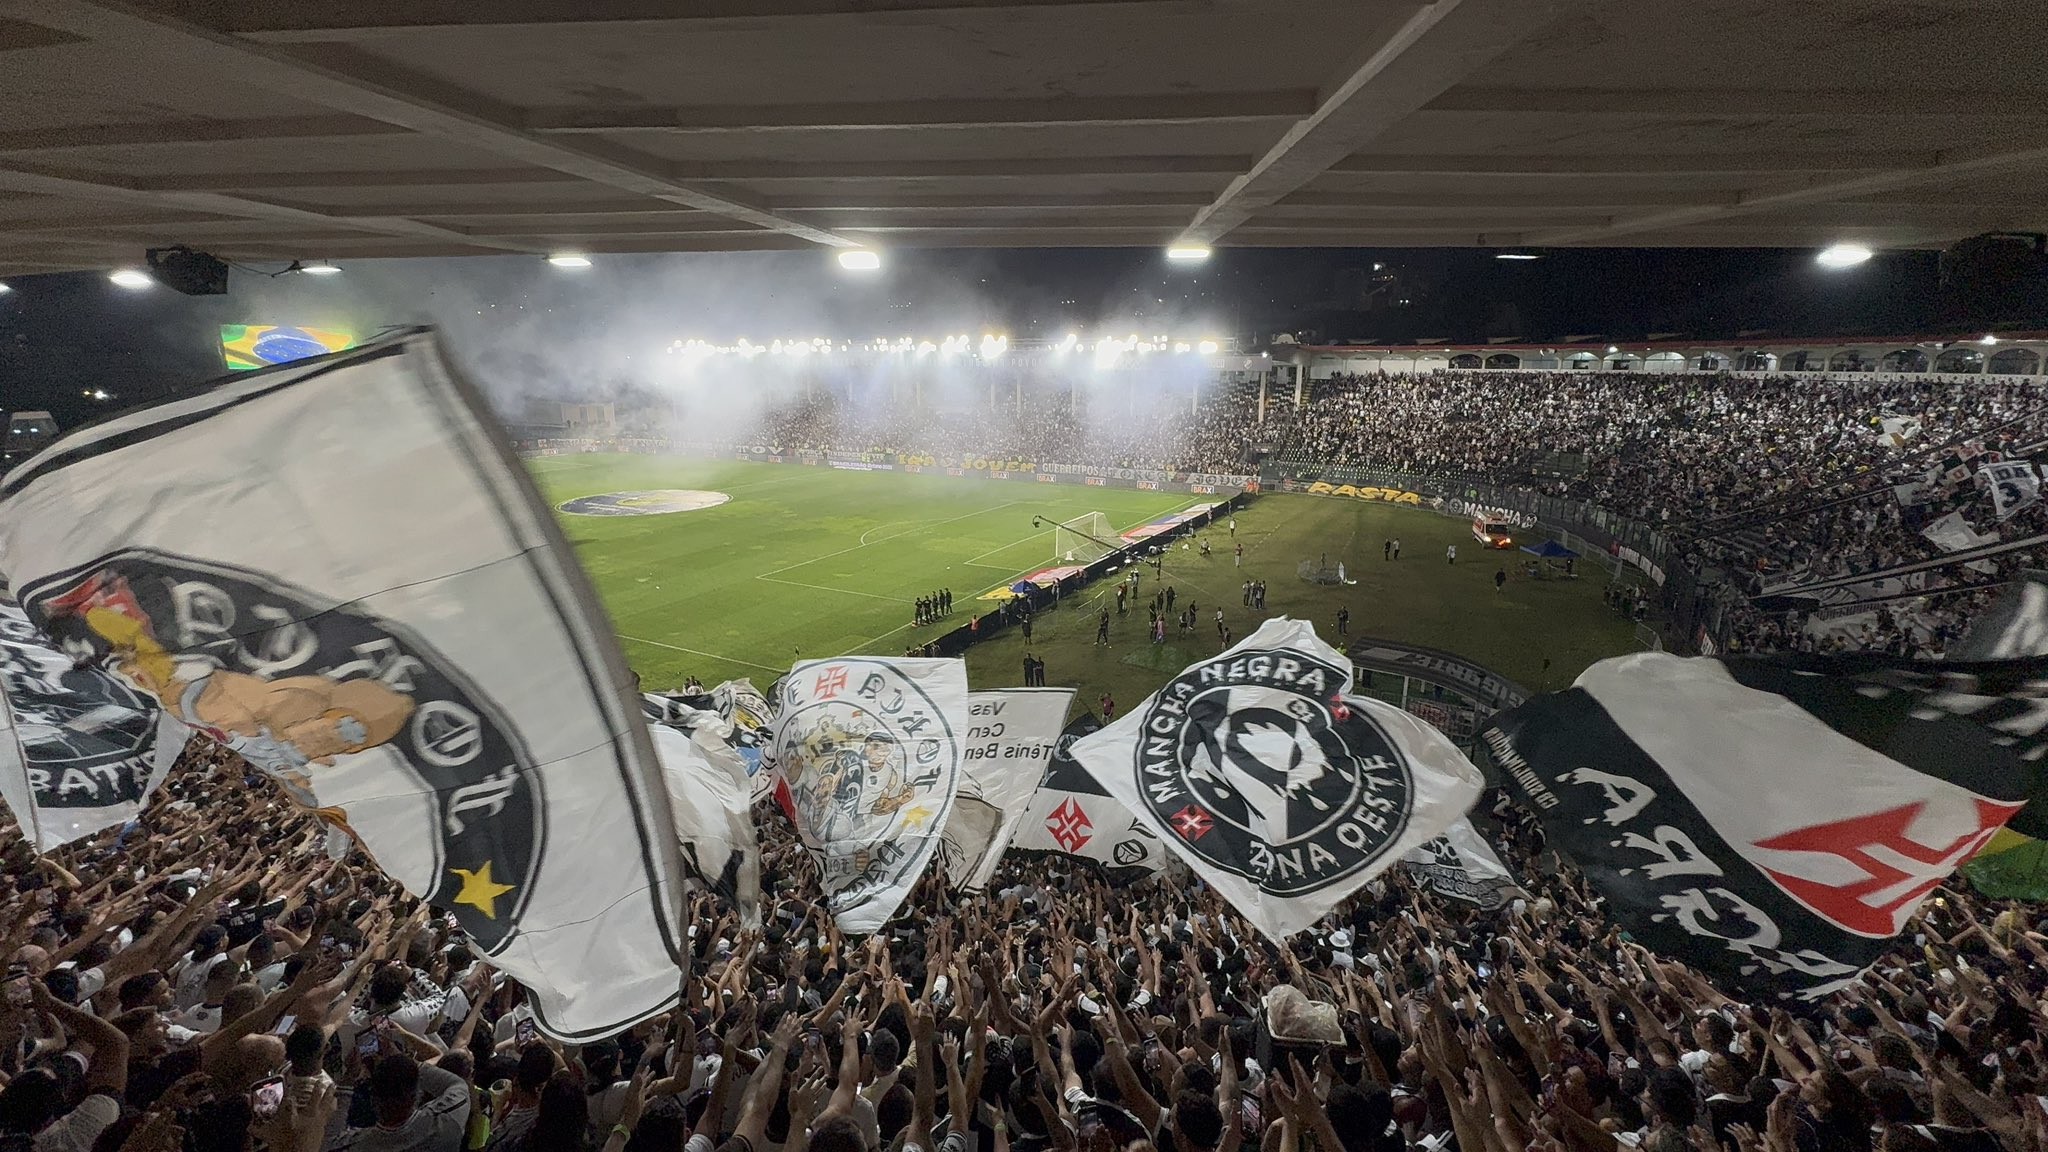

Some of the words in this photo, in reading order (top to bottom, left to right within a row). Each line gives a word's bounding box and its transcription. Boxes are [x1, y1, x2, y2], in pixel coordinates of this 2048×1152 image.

[736, 445, 784, 454] TOV
[960, 457, 1038, 473] JOVEM
[1039, 475, 1055, 483] BRAX
[1139, 482, 1157, 490] BRAX
[1193, 486, 1212, 494] BRAX
[1308, 481, 1420, 505] RASTA
[1144, 680, 1195, 804] MANCHA
[1200, 656, 1327, 695] NEGRA
[1336, 754, 1406, 855] OESTE
